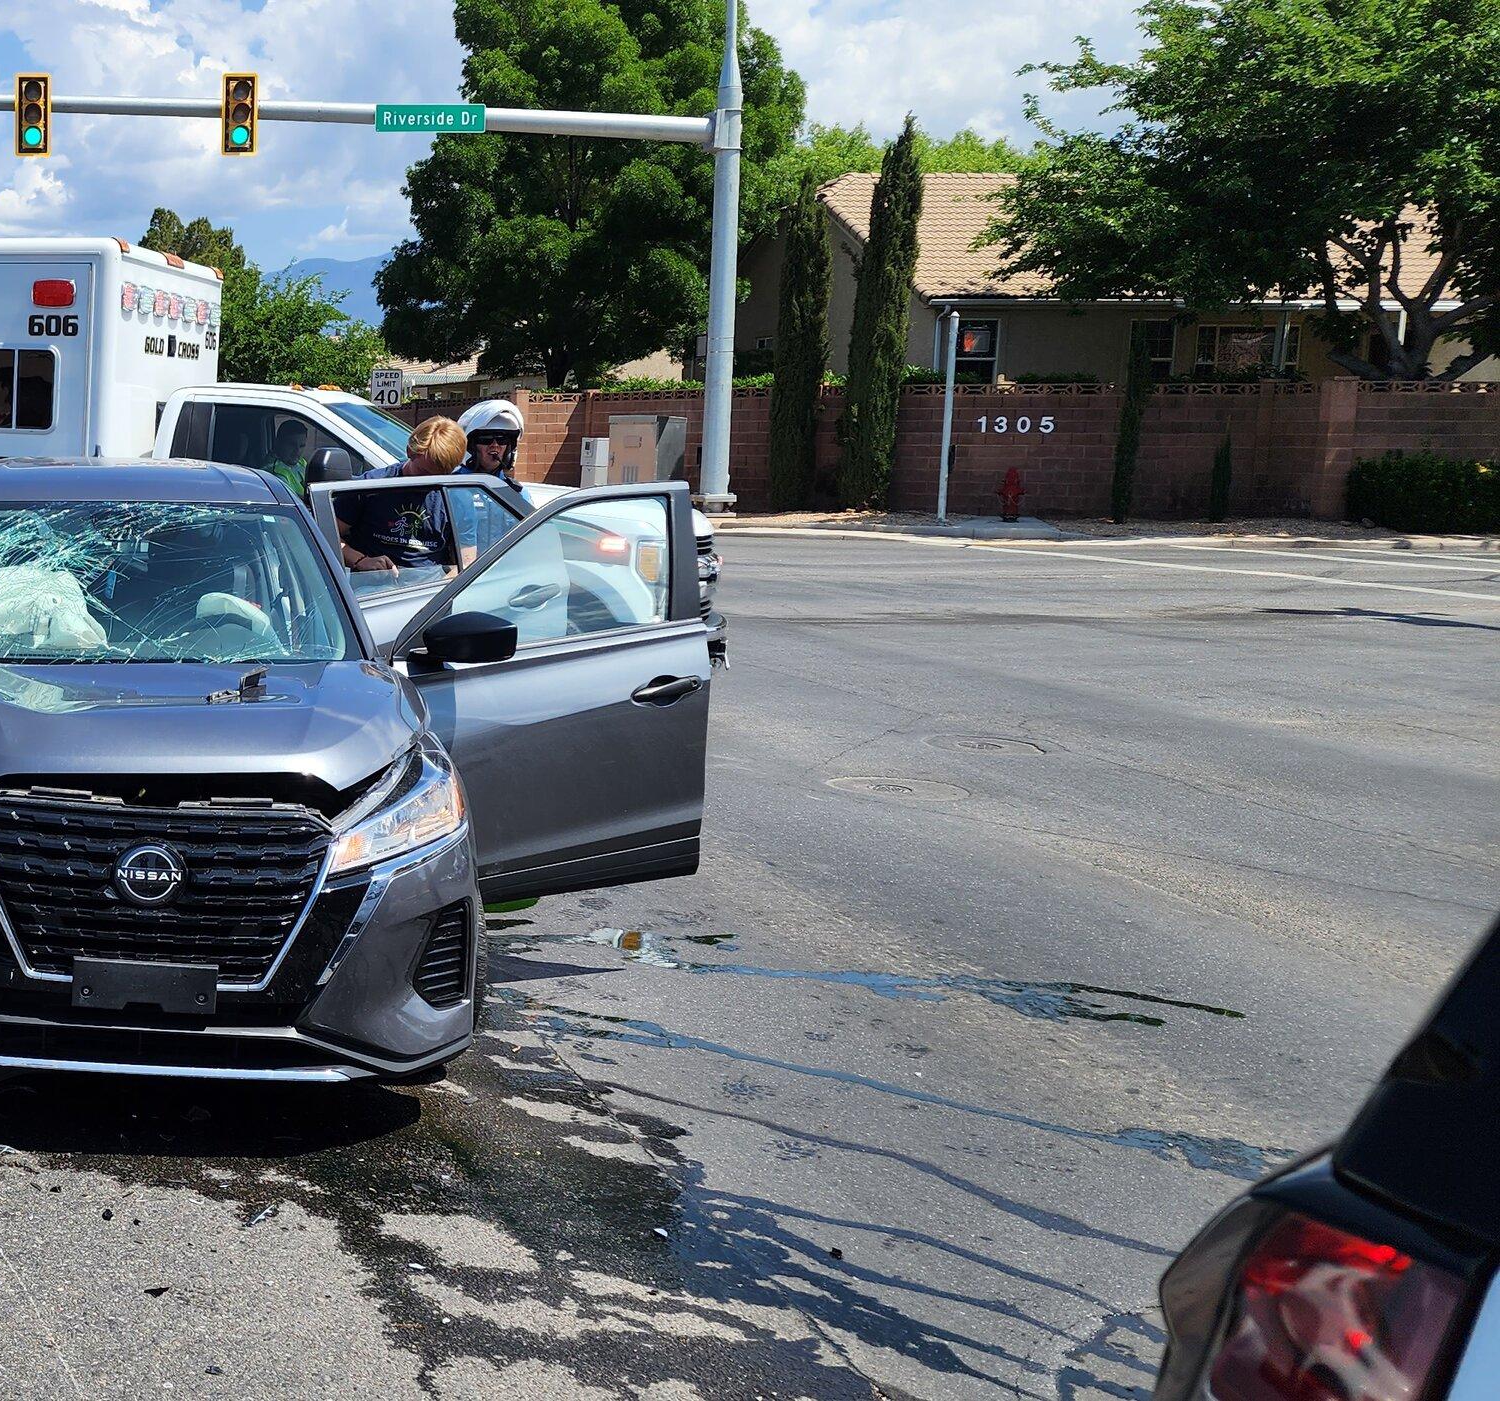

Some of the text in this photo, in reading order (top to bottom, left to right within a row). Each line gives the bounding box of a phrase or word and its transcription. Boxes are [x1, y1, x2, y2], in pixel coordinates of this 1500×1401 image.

[383, 111, 478, 126] Riverside Dr
[28, 314, 79, 337] 606
[144, 335, 200, 360] GOLD CROSS
[204, 331, 217, 351] 606
[376, 380, 397, 388] LIMIT
[373, 389, 399, 405] 40
[977, 415, 1055, 433] 1305
[117, 868, 182, 882] NISSAN
